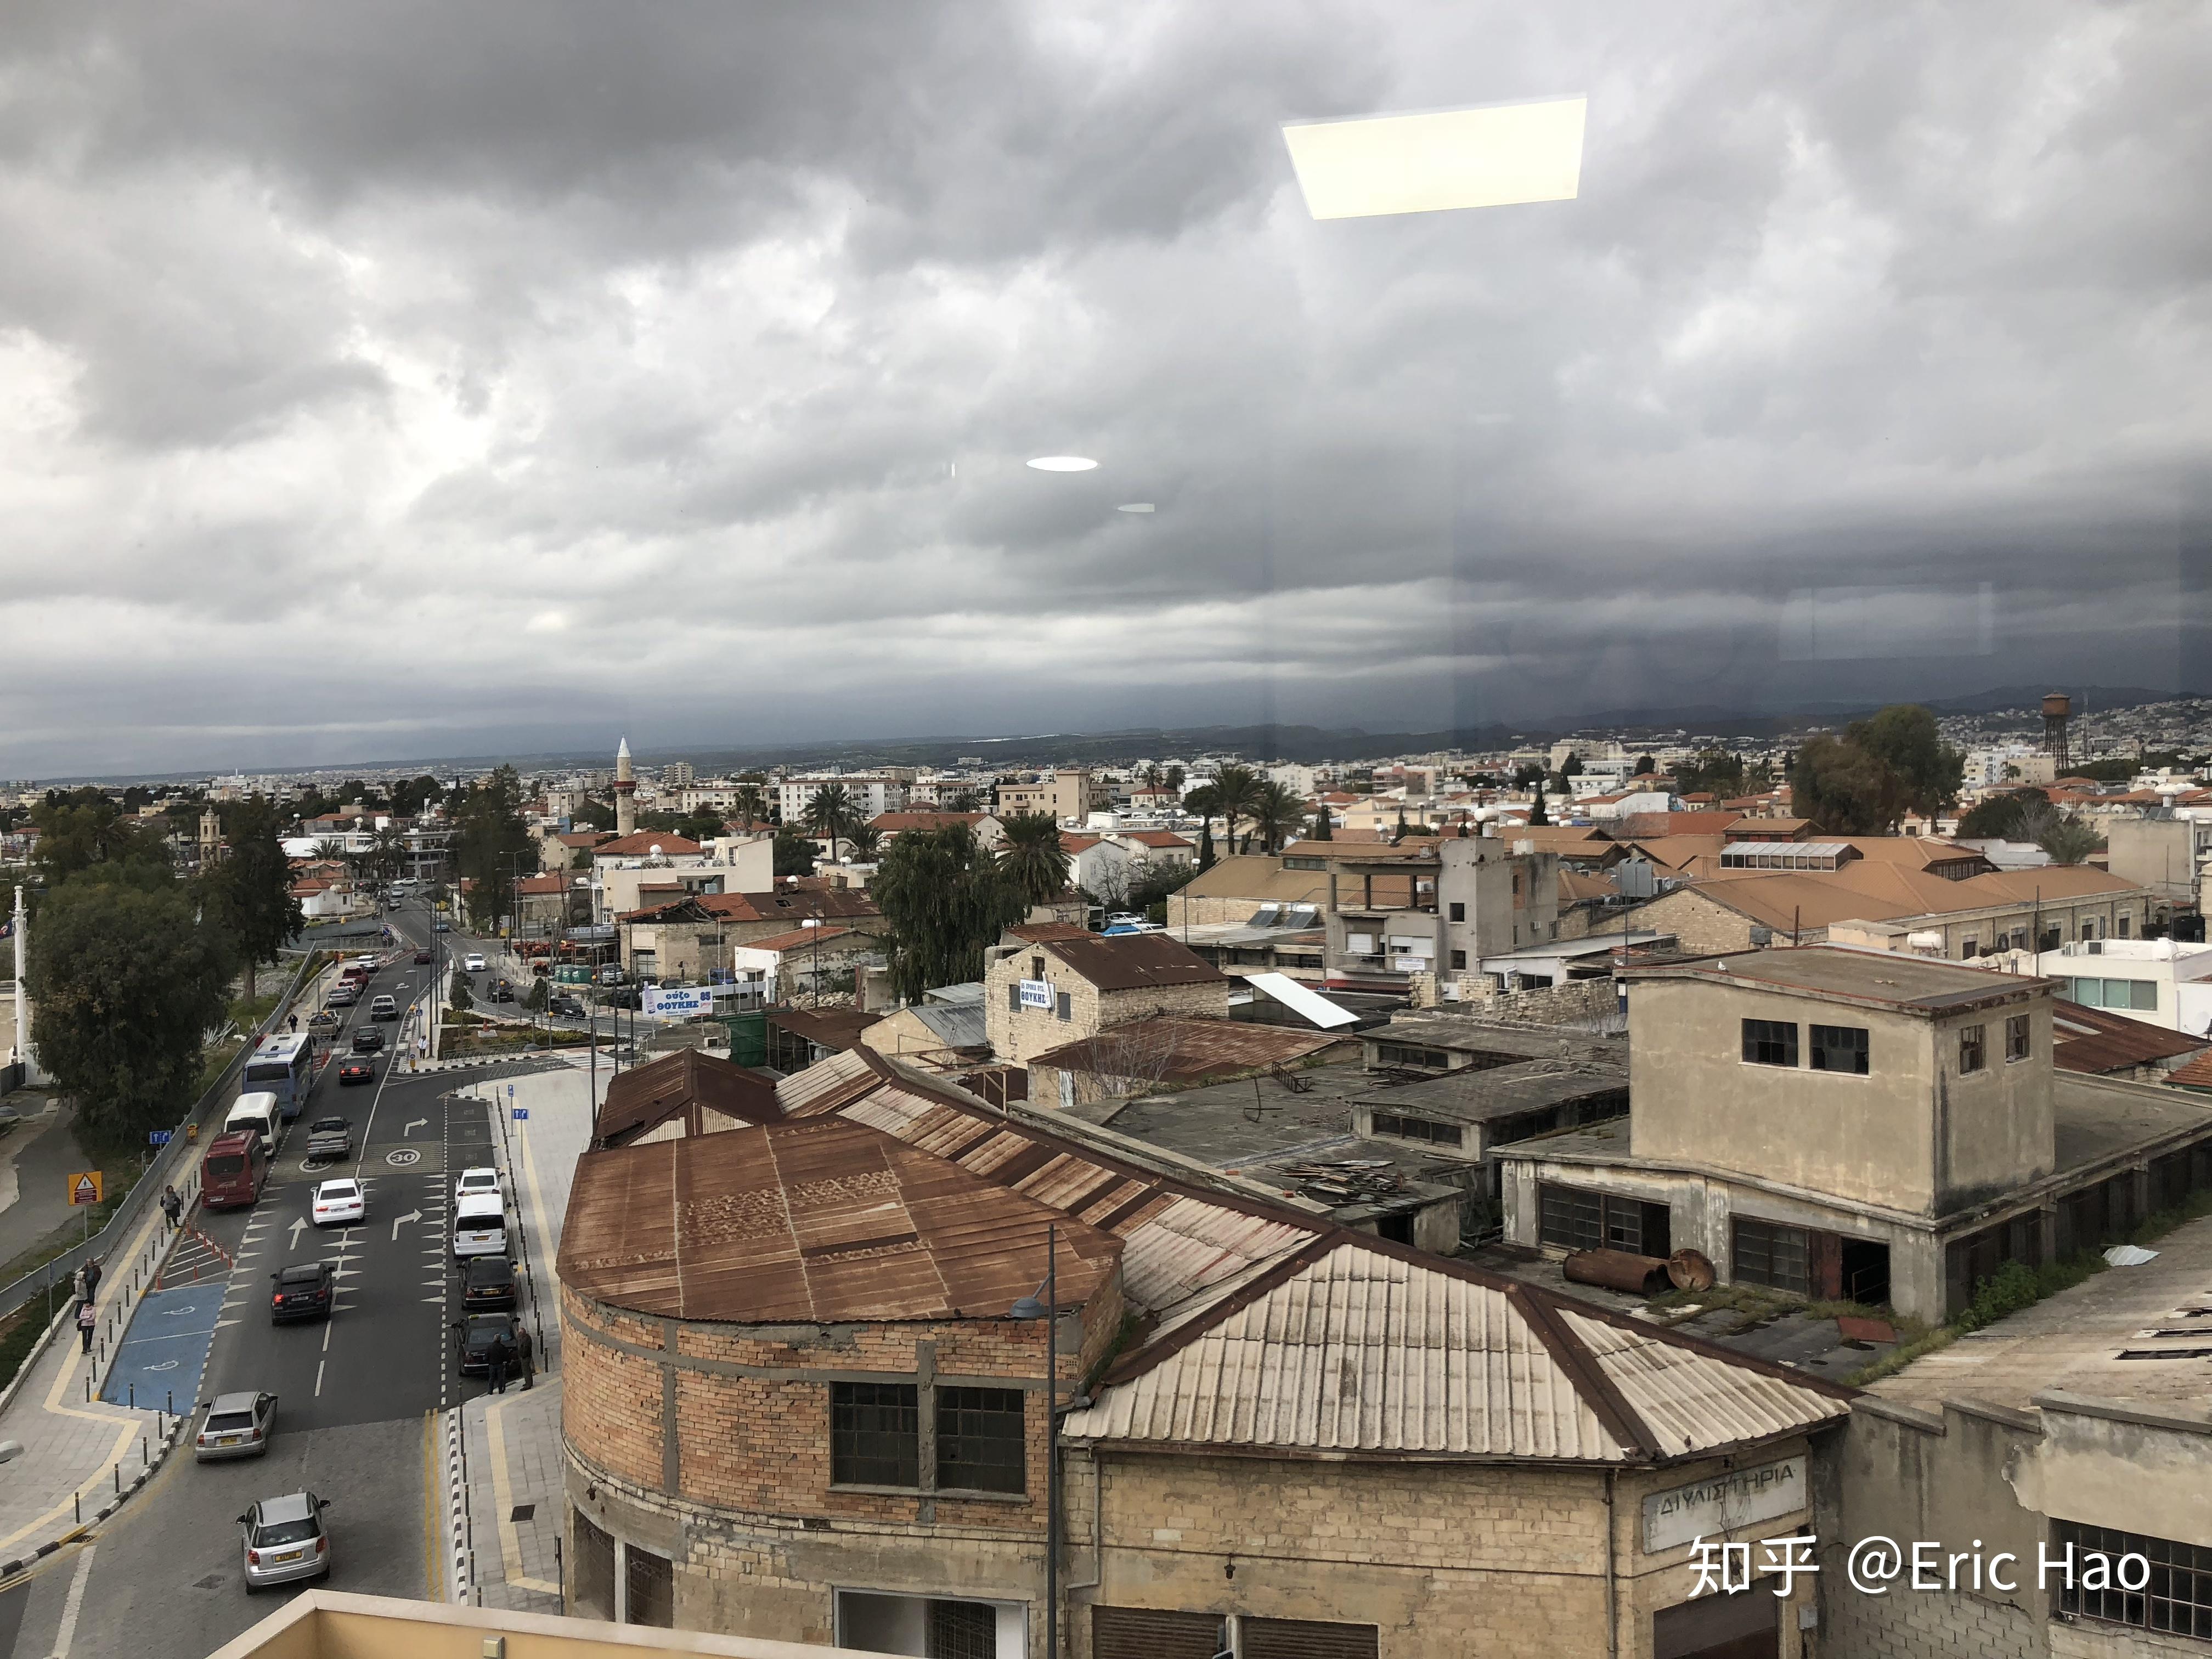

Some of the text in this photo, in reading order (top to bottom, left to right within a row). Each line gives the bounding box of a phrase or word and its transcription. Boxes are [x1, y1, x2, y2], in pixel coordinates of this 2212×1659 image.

[665, 991, 690, 1000] ούζο
[1022, 991, 1046, 1003] ΘΟΥΚΗΣ
[657, 1001, 699, 1010] ΘΟΥΚΗΣ
[391, 1153, 416, 1162] 30
[1661, 1464, 1794, 1515] ΔΙΥΛΙΣΤΗΡΙΑ
